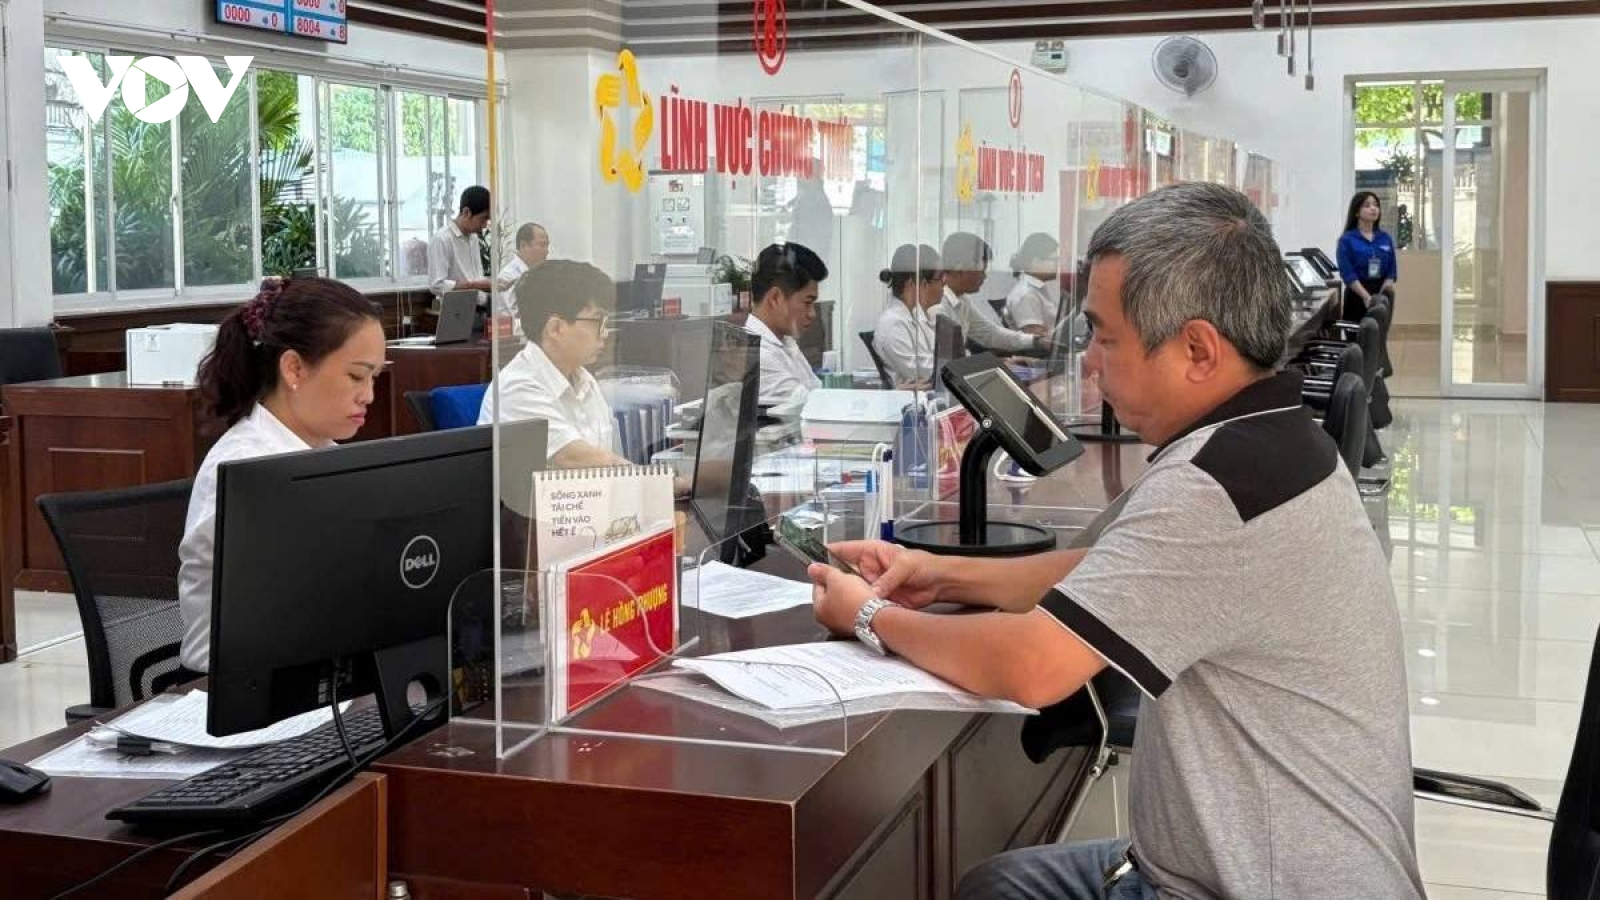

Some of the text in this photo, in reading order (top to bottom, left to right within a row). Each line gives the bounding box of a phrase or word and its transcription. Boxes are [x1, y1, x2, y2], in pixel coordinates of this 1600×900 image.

[224, 4, 278, 27] 0000 0
[296, 17, 321, 35] 8004
[660, 84, 708, 173] LĨNH
[714, 96, 753, 190] VỰC
[404, 553, 436, 572] DELL
